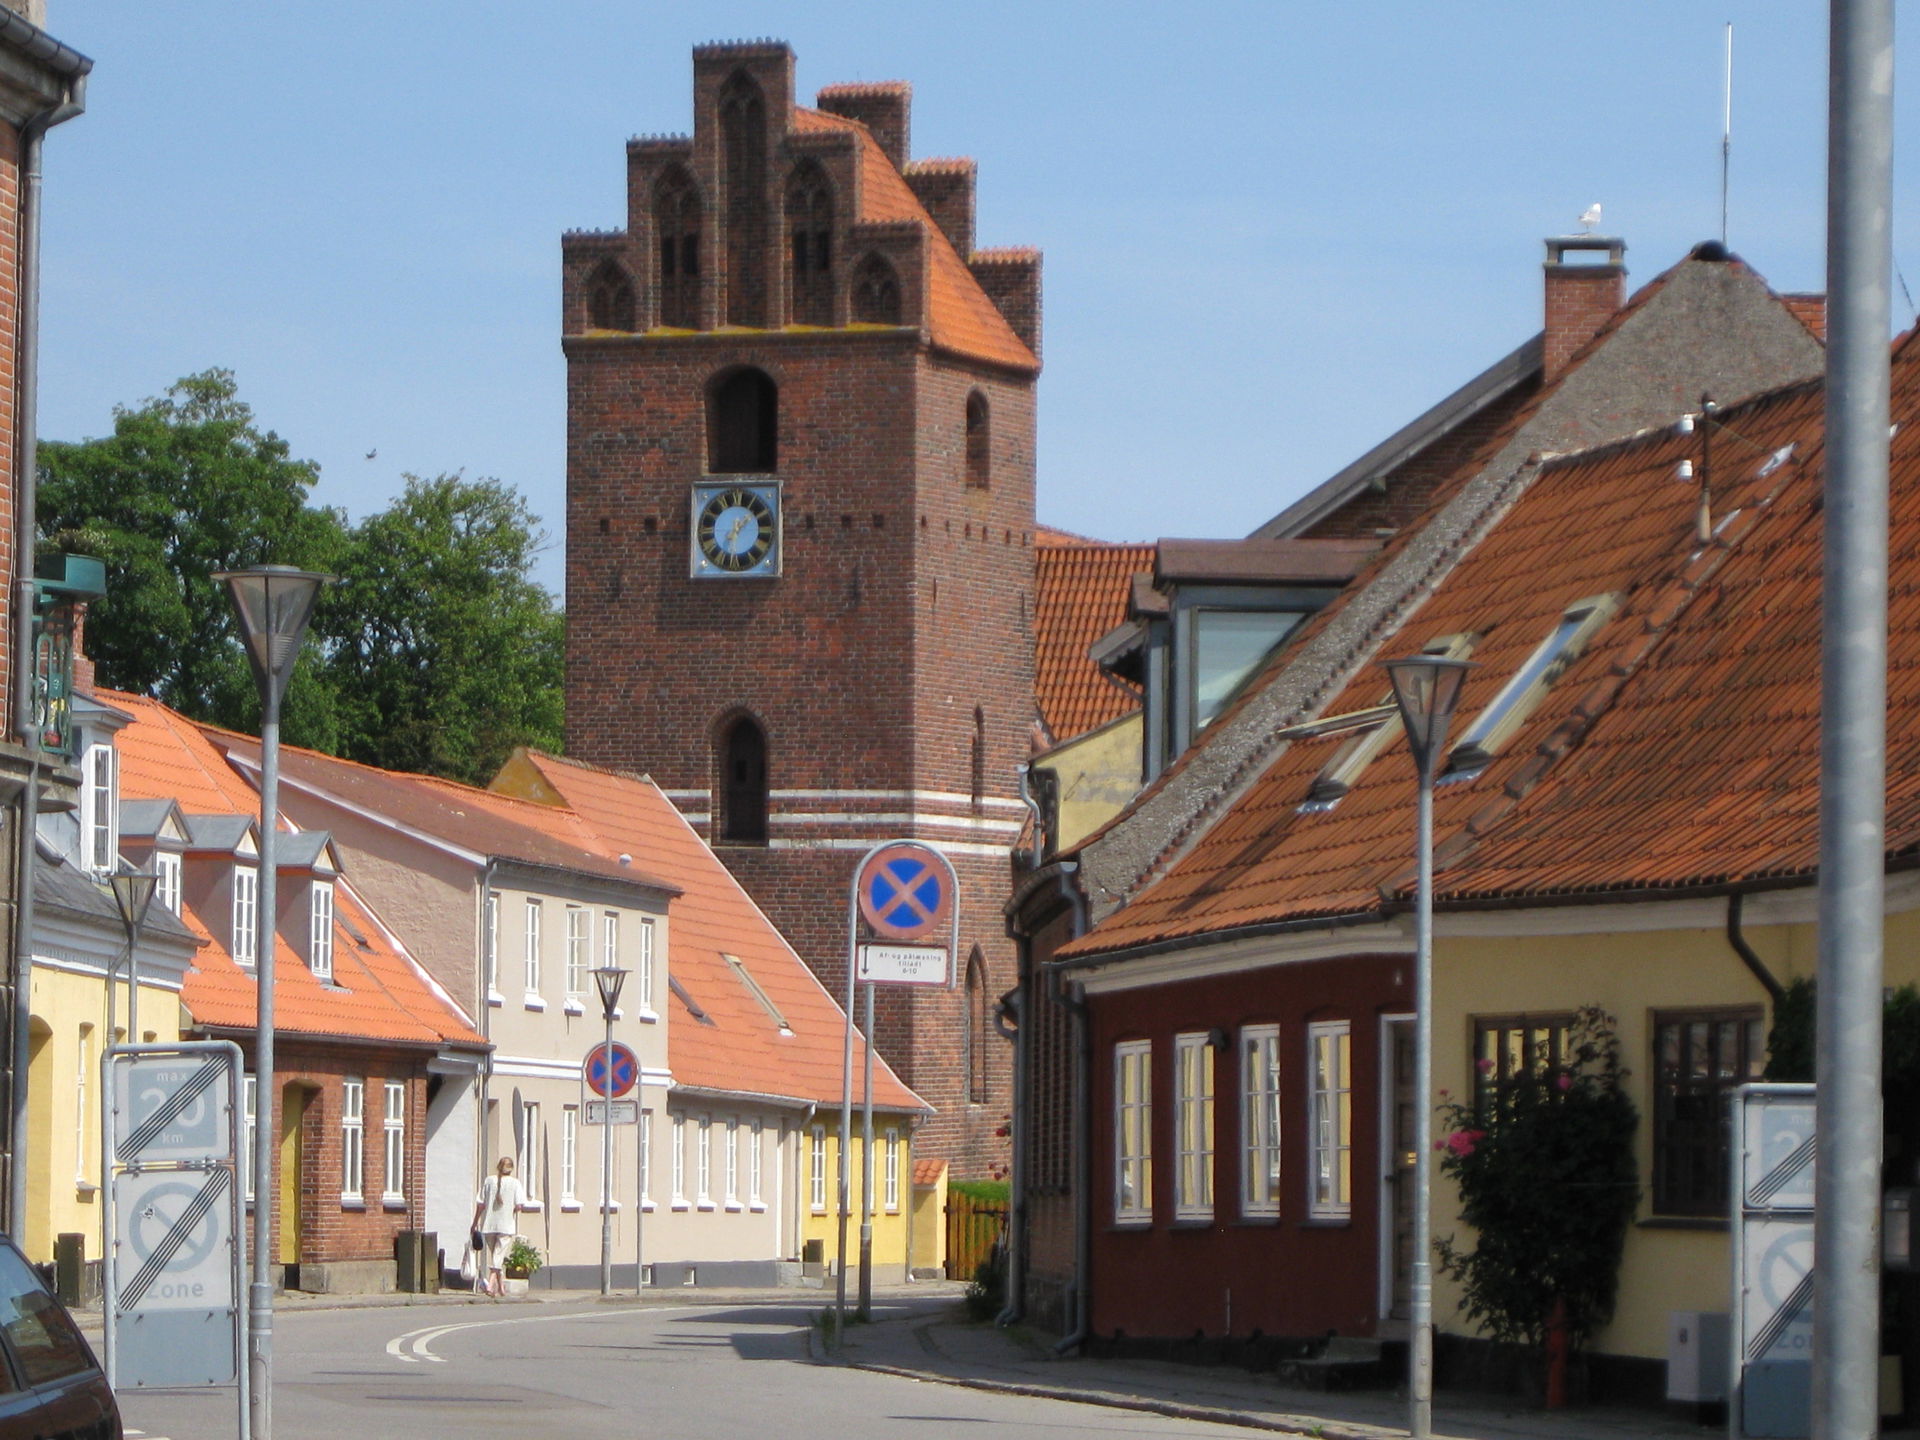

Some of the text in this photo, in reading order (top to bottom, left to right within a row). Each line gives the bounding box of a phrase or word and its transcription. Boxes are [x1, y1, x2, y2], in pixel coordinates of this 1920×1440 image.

[156, 1071, 188, 1082] max
[140, 1087, 205, 1128] 20
[162, 1132, 184, 1144] km
[145, 1280, 204, 1299] Zone
